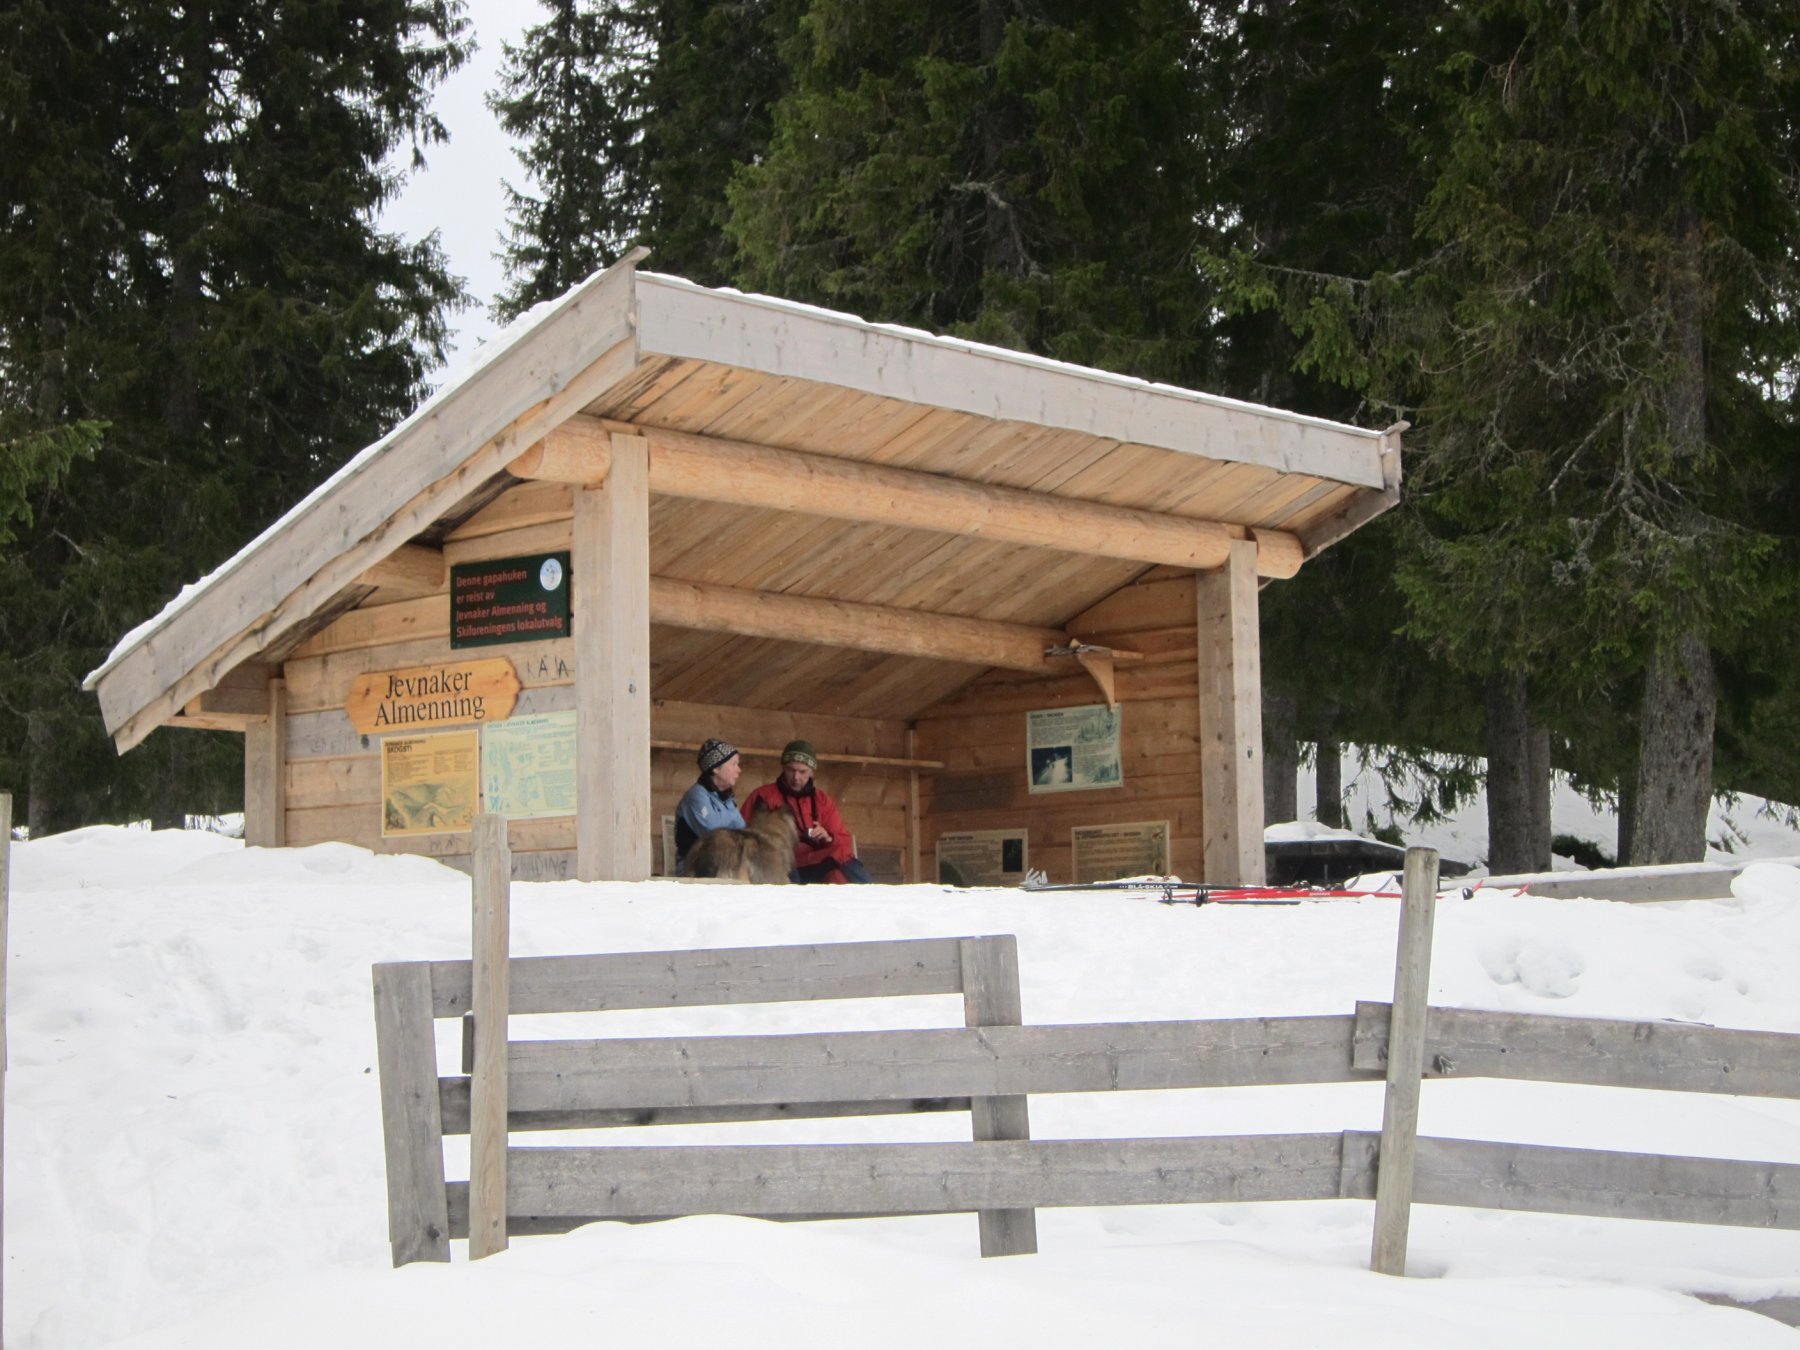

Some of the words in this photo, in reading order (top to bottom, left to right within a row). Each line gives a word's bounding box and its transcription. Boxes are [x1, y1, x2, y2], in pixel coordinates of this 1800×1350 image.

[456, 575, 481, 588] Denne
[483, 569, 528, 586] gapahuken
[456, 595, 464, 604] er
[466, 591, 484, 602] reist
[485, 591, 495, 601] av
[456, 608, 490, 622] Jevnaker
[491, 602, 534, 616] Almenning
[535, 602, 547, 613] og
[456, 622, 516, 637] Skiforeningens
[517, 616, 563, 630] lokalutvalg
[385, 669, 473, 699] Jevnaker
[374, 694, 486, 727] Almenning
